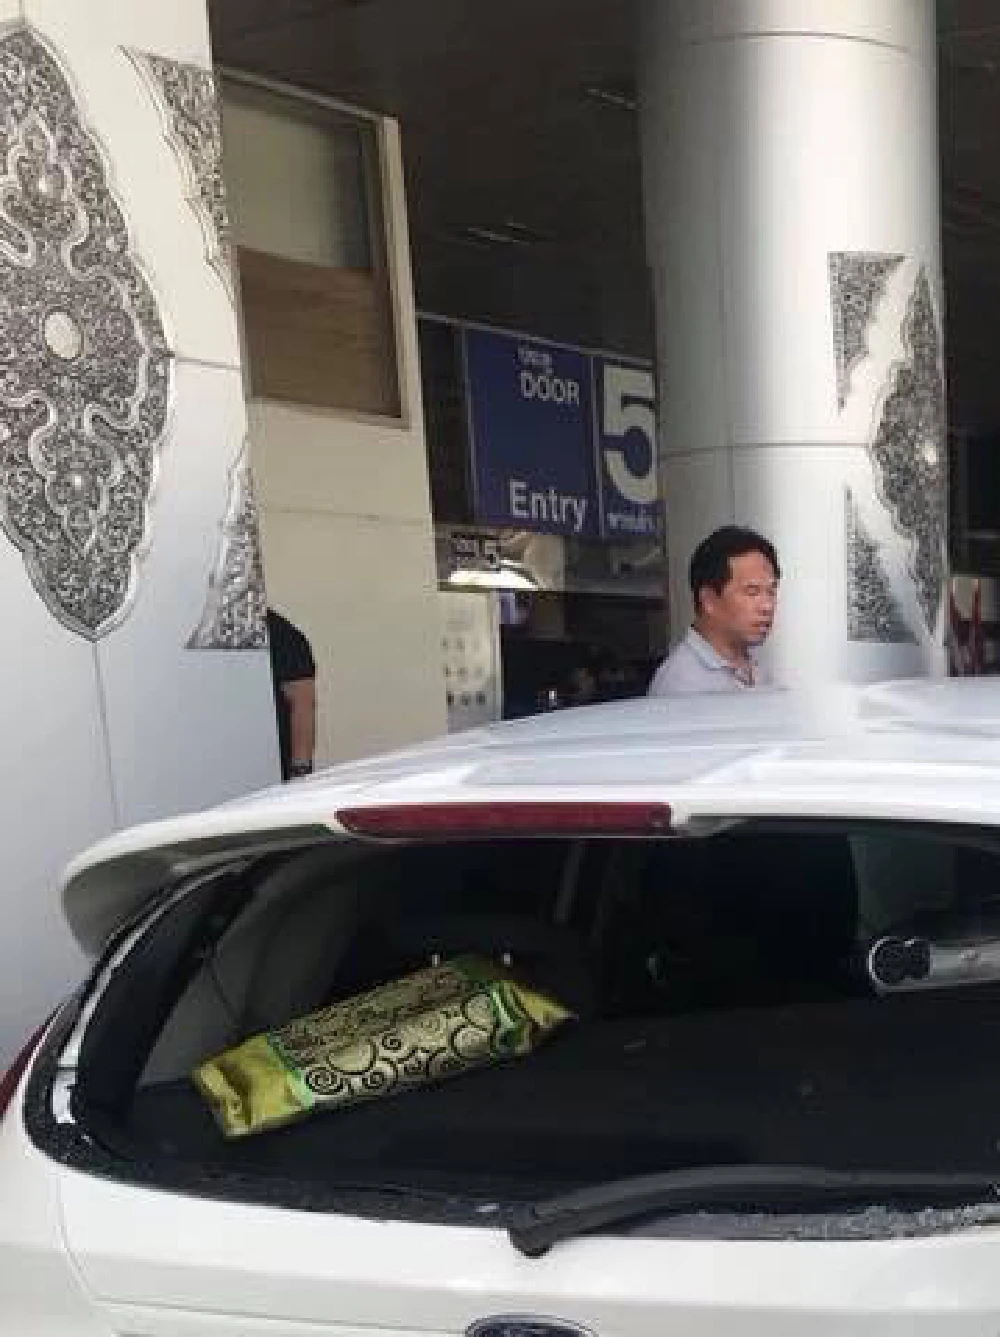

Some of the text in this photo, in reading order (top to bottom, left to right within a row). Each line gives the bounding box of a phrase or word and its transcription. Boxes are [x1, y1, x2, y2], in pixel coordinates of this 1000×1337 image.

[519, 373, 580, 407] DOOR
[603, 364, 658, 502] 5
[509, 478, 588, 532] Entry
